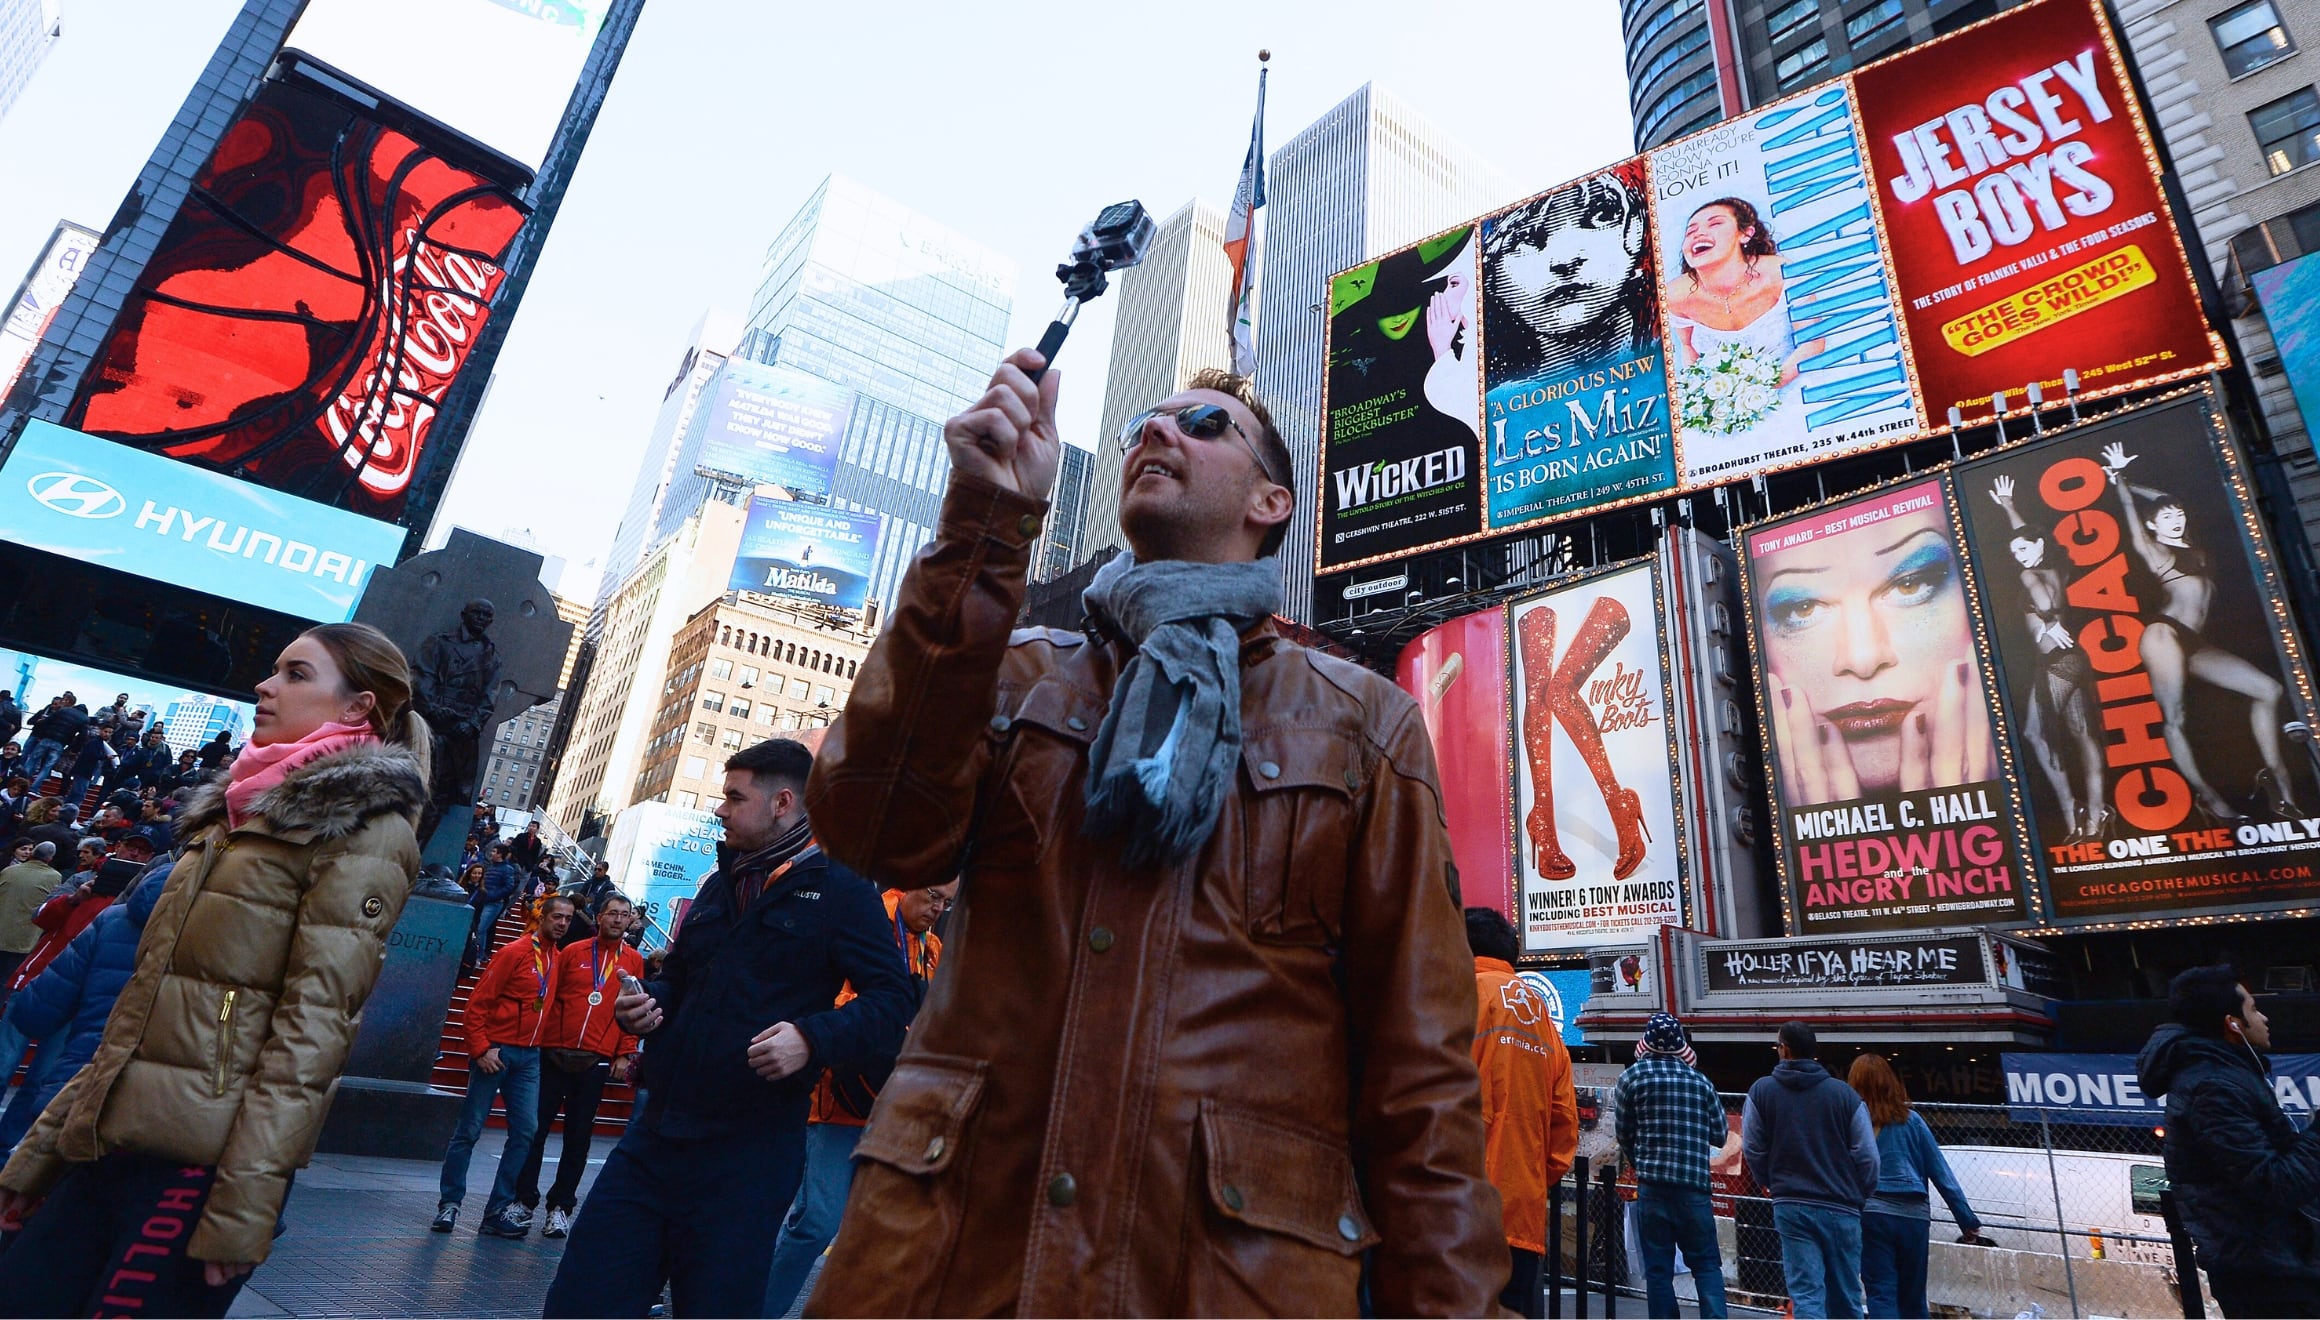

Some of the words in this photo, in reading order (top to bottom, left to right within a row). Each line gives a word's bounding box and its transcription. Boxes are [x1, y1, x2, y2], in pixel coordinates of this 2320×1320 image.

[1889, 49, 2114, 204] JERSEY
[1653, 147, 1682, 164] YOU
[1684, 126, 1738, 151] ALREADY
[1655, 151, 1703, 177] KNOW
[1706, 130, 1756, 156] YOU'RE
[1754, 88, 1867, 218] MIA!
[1656, 158, 1713, 186] GONNA
[1658, 172, 1710, 200] LOVE
[1717, 159, 1741, 180] IT!
[1933, 140, 2116, 266] BOYS
[1912, 295, 1933, 310] THE
[1933, 284, 1963, 303] STORY
[1963, 279, 1978, 293] OF
[1978, 262, 2020, 287] FRANKIE
[2018, 252, 2049, 273] VALLI
[2049, 248, 2060, 260] &
[2057, 240, 2081, 257] THE
[2080, 231, 2110, 250] FOUR
[2108, 211, 2158, 239] SEASONS
[2021, 252, 2131, 306] CROWD
[1777, 199, 1913, 433] MAMMA
[1962, 307, 2044, 347] GOES
[2083, 368, 2104, 380] 245
[2105, 360, 2133, 374] West
[2160, 350, 2177, 361] St.
[1508, 371, 1606, 412] GLORIOUS
[1609, 355, 1656, 384] NEW
[1334, 407, 1381, 430] BIGGEST
[1334, 404, 1420, 441] BLOCKBUSTER"
[1699, 453, 1763, 476] BROADHURST
[1764, 444, 1810, 467] THEATRE,
[1812, 437, 1833, 449] 235
[1879, 417, 1916, 433] STREET
[1519, 456, 1579, 489] BORN
[1503, 502, 1545, 519] IMPERIAL
[1546, 489, 1590, 508] THEATRE
[1596, 484, 1611, 497] 249
[1612, 480, 1624, 492] W.
[1625, 473, 1650, 490] 45TH
[1651, 472, 1667, 484] ST.
[826, 520, 851, 531] AND
[1345, 524, 1381, 539] GERSHWIN
[1414, 513, 1428, 523] 222
[1428, 510, 1438, 519] W.
[1437, 506, 1455, 517] 51ST
[1455, 503, 1467, 513] ST.
[1759, 538, 1781, 553] TONY
[1783, 529, 1814, 548] AWARD
[1825, 518, 1848, 536] BEST
[1849, 507, 1891, 529] MUSICAL
[1892, 494, 1935, 516] REVIVAL
[134, 500, 366, 587] HYUNDAI
[764, 567, 837, 595] Matilda
[1350, 585, 1367, 596] city
[1367, 578, 1403, 592] outdoor
[2039, 457, 2192, 831] CHICAGO
[1598, 700, 1660, 734] Boots
[1794, 803, 1895, 841] MICHAEL
[1899, 800, 1925, 828] C.
[1929, 790, 1998, 825] HALL
[681, 838, 699, 852] 20
[701, 842, 714, 855] @
[1800, 825, 2005, 882] HEDWIG
[2049, 842, 2106, 864] THE
[2108, 835, 2170, 859] ONE
[2172, 828, 2234, 850] THE
[2236, 817, 2320, 847] ONLY
[653, 869, 692, 882] BIGGER...
[663, 863, 687, 873] CHIN.
[1883, 869, 1904, 879] and
[1911, 866, 1930, 877] the
[2053, 866, 2068, 874] THE
[2069, 859, 2142, 873] LONGEST-RUNNING
[2144, 855, 2186, 867] AMERICAN
[2187, 851, 2224, 862] MUSICAL
[2225, 850, 2236, 858] IN
[2238, 844, 2289, 857] BROADWAY
[1528, 889, 1576, 910] WINNER!
[1579, 888, 1586, 906] 6
[1589, 885, 1620, 905] TONY
[1623, 880, 1675, 901] AWARDS
[1805, 876, 1917, 908] ANGRY
[1925, 865, 2013, 898] INCH
[2079, 866, 2313, 897] CHICAGOTHEMUSICAL.COM
[1529, 908, 1581, 922] INCLUDING
[1583, 906, 1614, 918] BEST
[1617, 901, 1677, 916] MUSICAL
[1600, 918, 1610, 927] FOR
[1610, 916, 1630, 928] TICKETS
[1630, 916, 1643, 926] CALL
[1814, 911, 1841, 921] BELASCO
[1872, 907, 1882, 917] 111
[1883, 908, 1892, 916] W.
[1906, 904, 1931, 914] STREET
[1936, 898, 2016, 912] HEDWIGBROADWAY.COM
[390, 931, 449, 953] DUFFY
[1723, 951, 1793, 977] HOLLER
[1851, 948, 1912, 974] HEAR
[1917, 947, 1958, 971] ME
[1738, 974, 1747, 985] A
[2006, 1072, 2167, 1107] MONE
[93, 1188, 201, 1320] HOLLI
